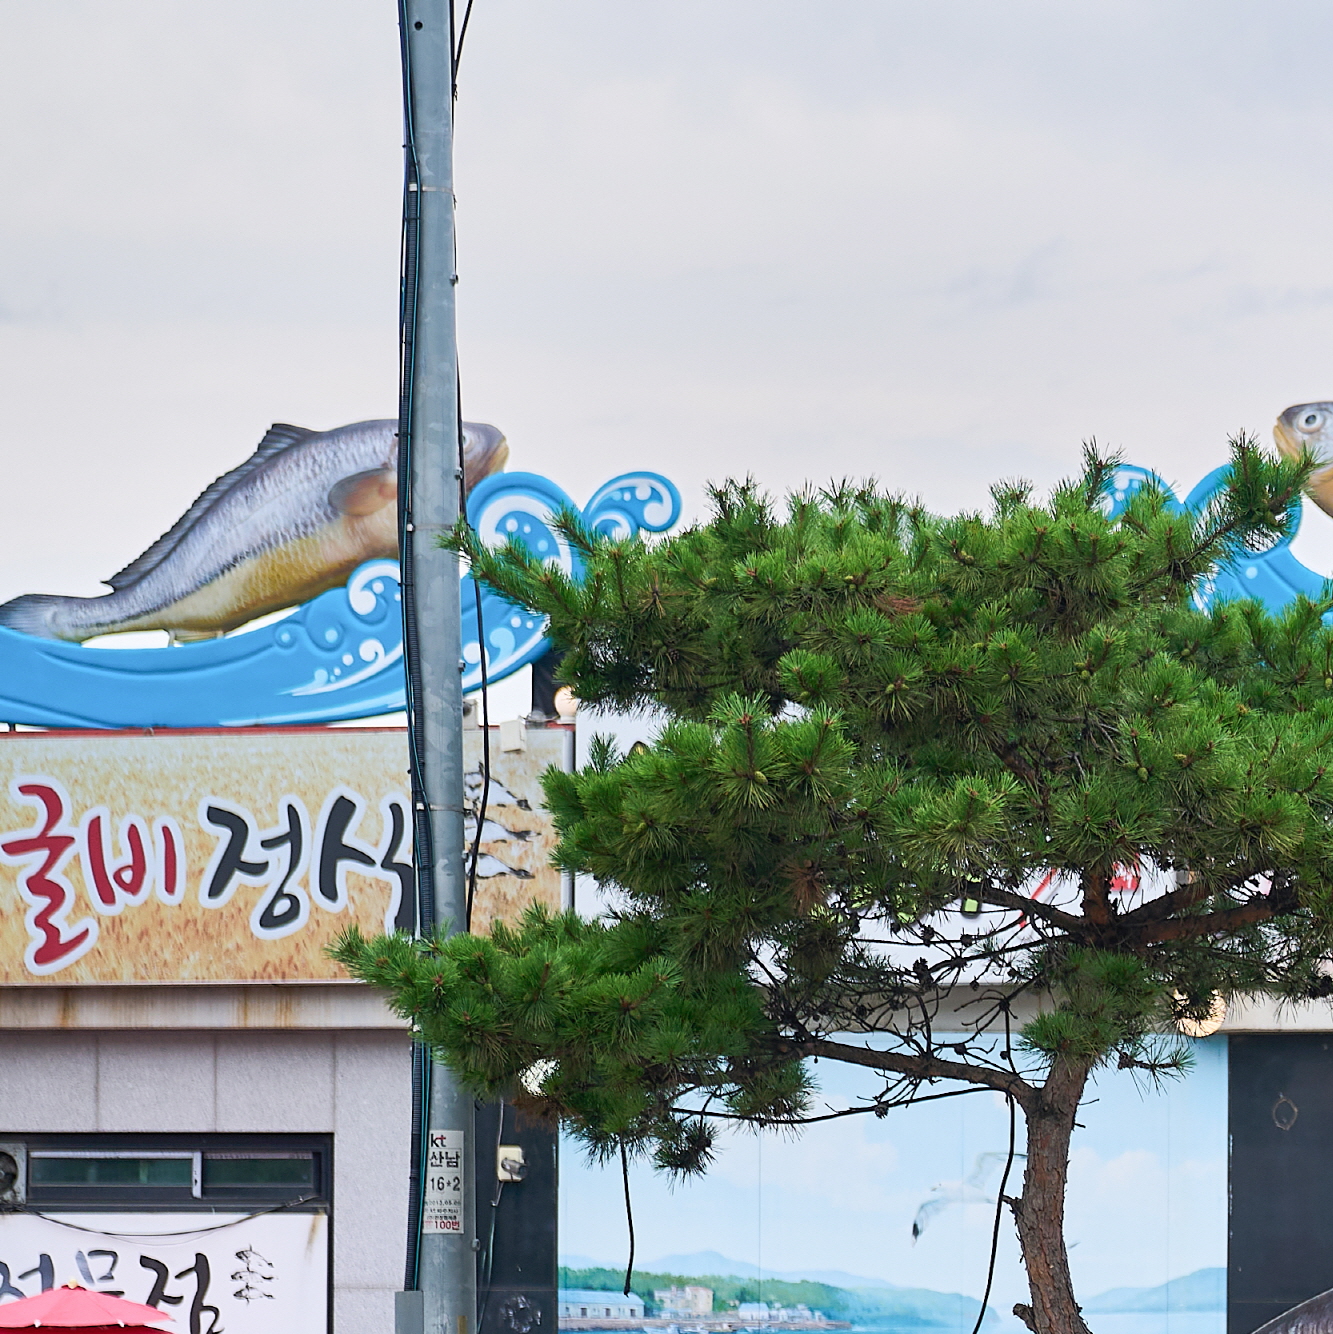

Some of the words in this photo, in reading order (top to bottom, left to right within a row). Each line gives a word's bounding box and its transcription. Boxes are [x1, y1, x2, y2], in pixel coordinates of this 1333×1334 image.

[1, 783, 177, 966] 굴비
[430, 1132, 447, 1148] kt
[429, 1150, 461, 1168] 산남
